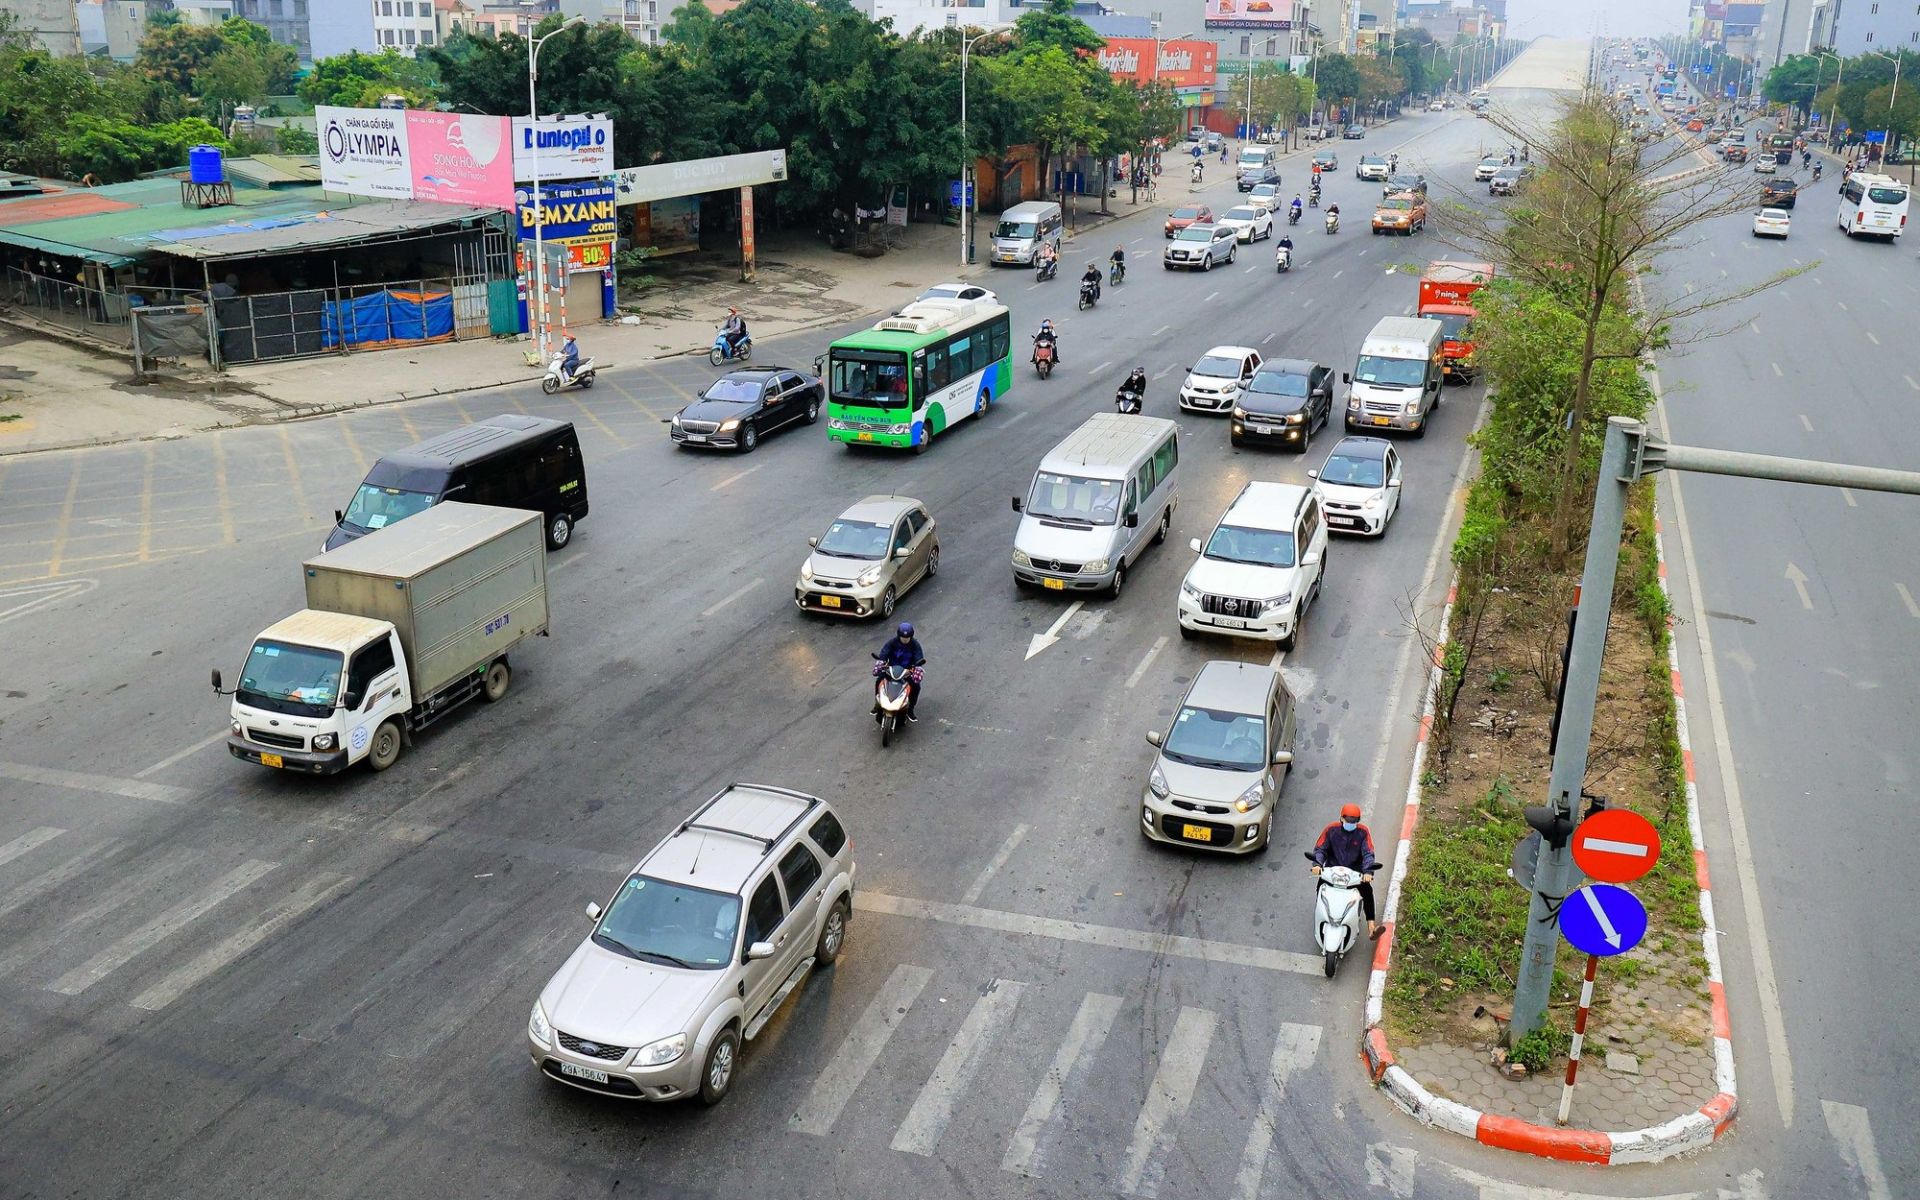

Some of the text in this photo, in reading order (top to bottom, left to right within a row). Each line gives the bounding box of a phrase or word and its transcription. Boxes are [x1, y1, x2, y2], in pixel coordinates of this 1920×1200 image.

[345, 117, 361, 128] CHĂN
[361, 120, 370, 128] GA
[370, 117, 381, 129] GỐI
[381, 119, 395, 132] ĐỆM
[327, 126, 402, 157] OLYMPIA
[524, 125, 605, 150] Dunlopilo
[588, 222, 615, 233] .com
[1441, 290, 1459, 299] ninja
